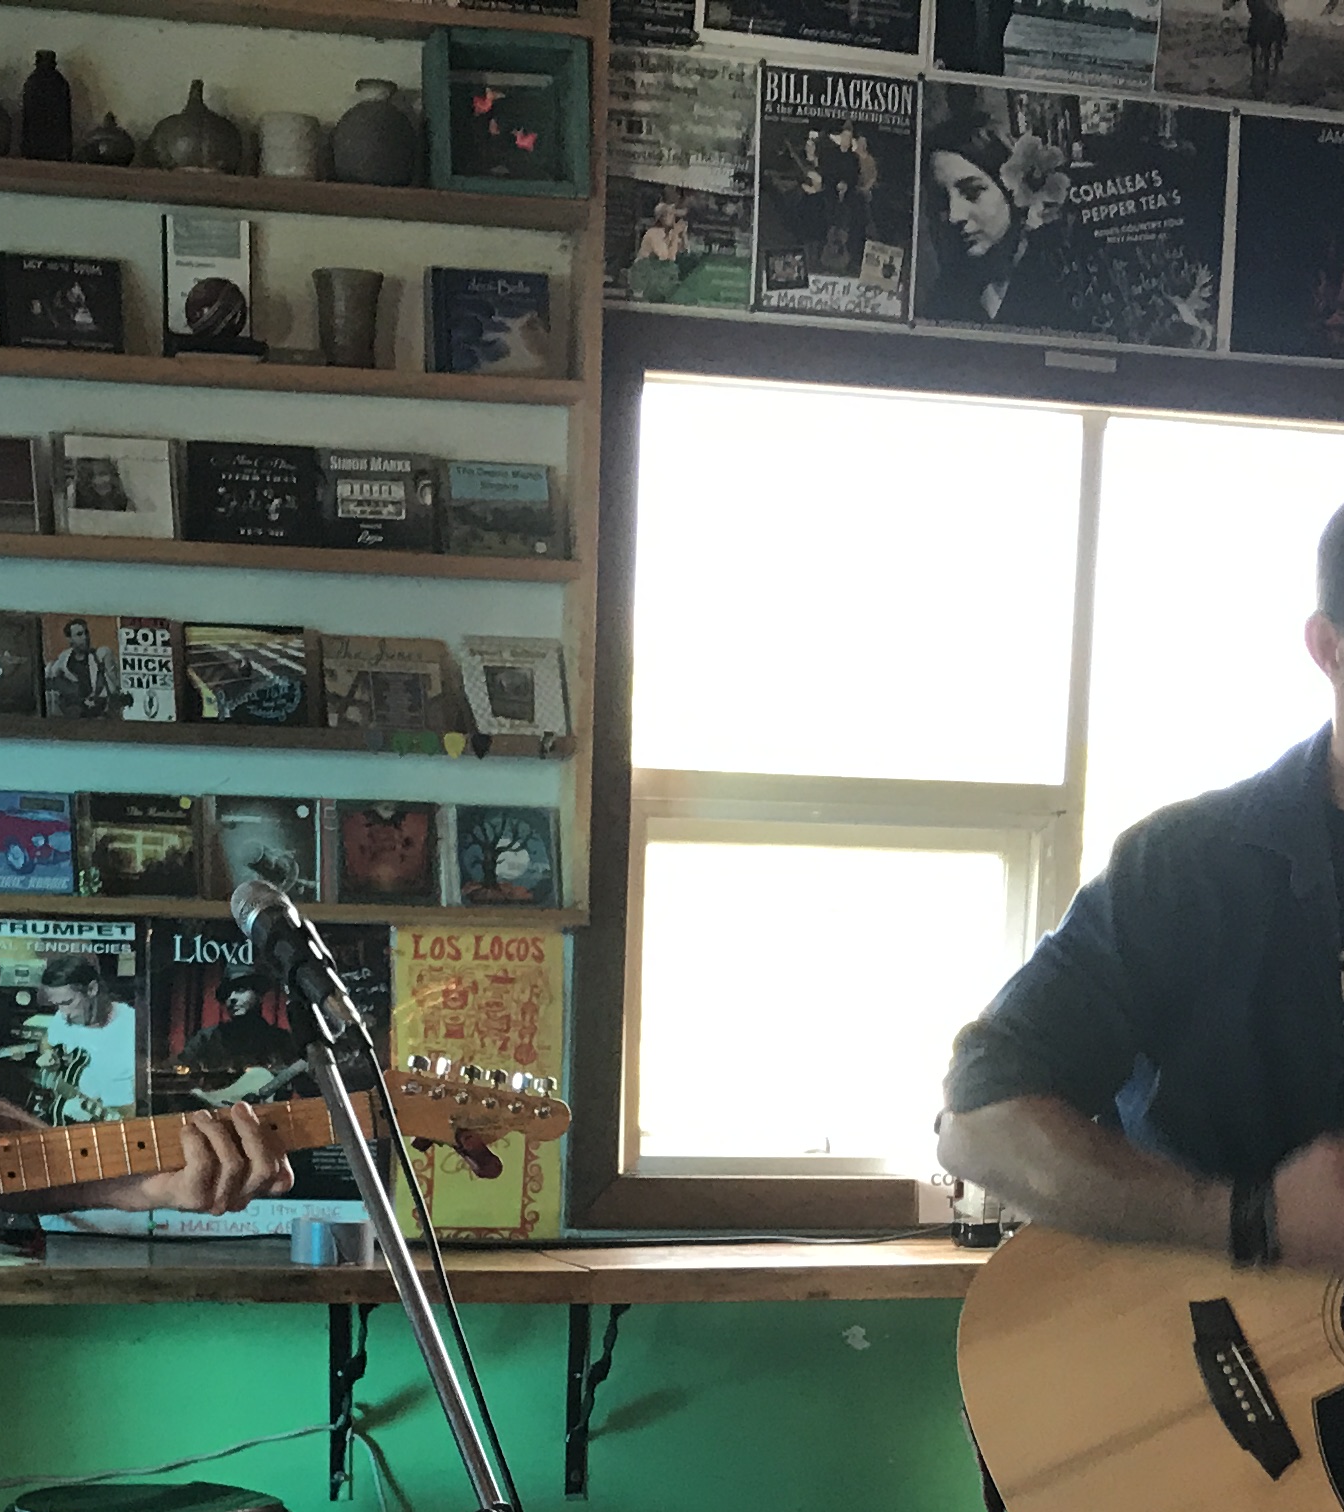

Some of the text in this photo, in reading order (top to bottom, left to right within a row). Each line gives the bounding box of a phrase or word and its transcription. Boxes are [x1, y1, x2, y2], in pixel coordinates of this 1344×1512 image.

[765, 71, 914, 116] BILL JACKSON
[1069, 169, 1163, 204] CORALEA'S
[1082, 188, 1181, 225] PEPPER TEA'S
[120, 628, 171, 648] POP
[122, 657, 171, 673] NICK
[25, 941, 132, 955] TENDENCIES
[172, 933, 255, 966] Lloyd
[412, 933, 545, 964] LOS LOCOS
